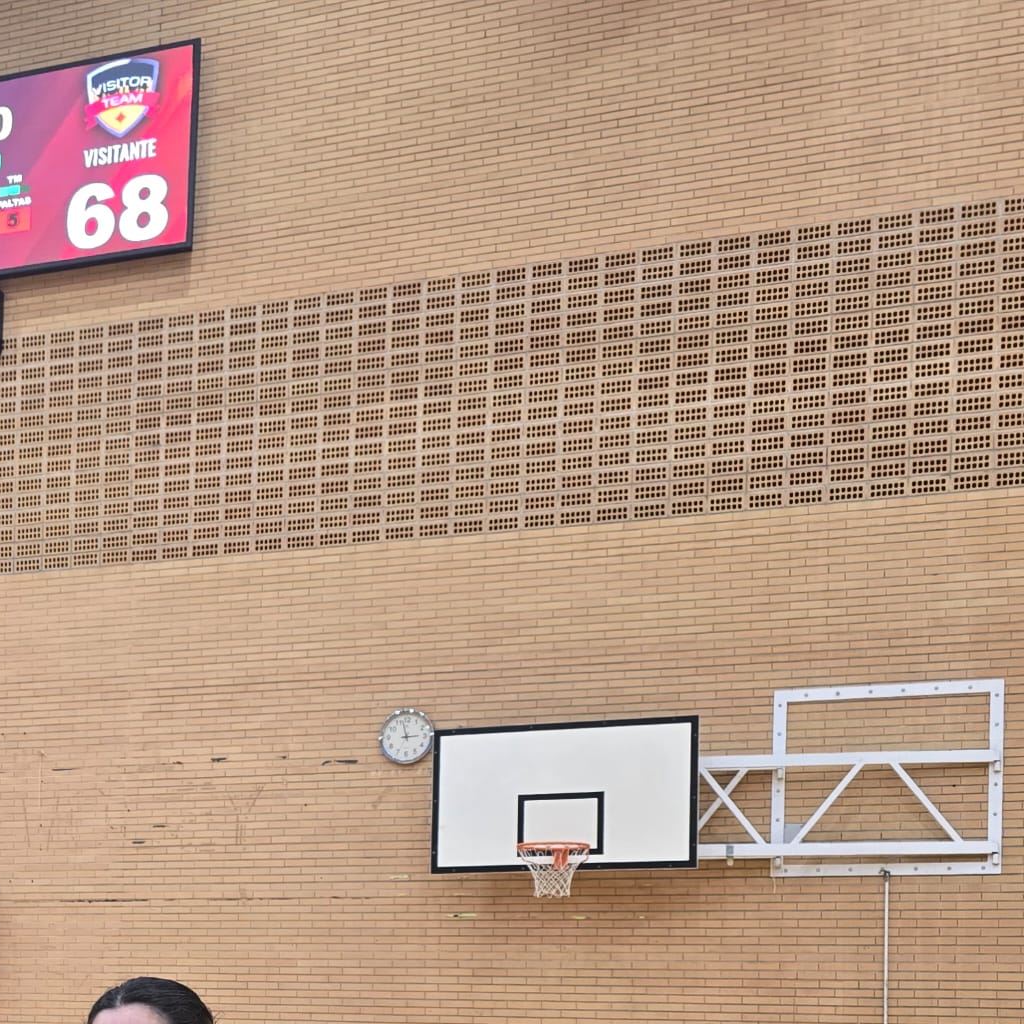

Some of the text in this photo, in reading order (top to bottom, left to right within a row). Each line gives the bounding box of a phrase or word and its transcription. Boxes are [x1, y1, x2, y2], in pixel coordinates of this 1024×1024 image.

[92, 76, 152, 95] VISITOR
[102, 93, 143, 109] TEAM
[83, 138, 158, 168] VISITANTE
[7, 213, 18, 227] 5
[67, 173, 169, 250] 68
